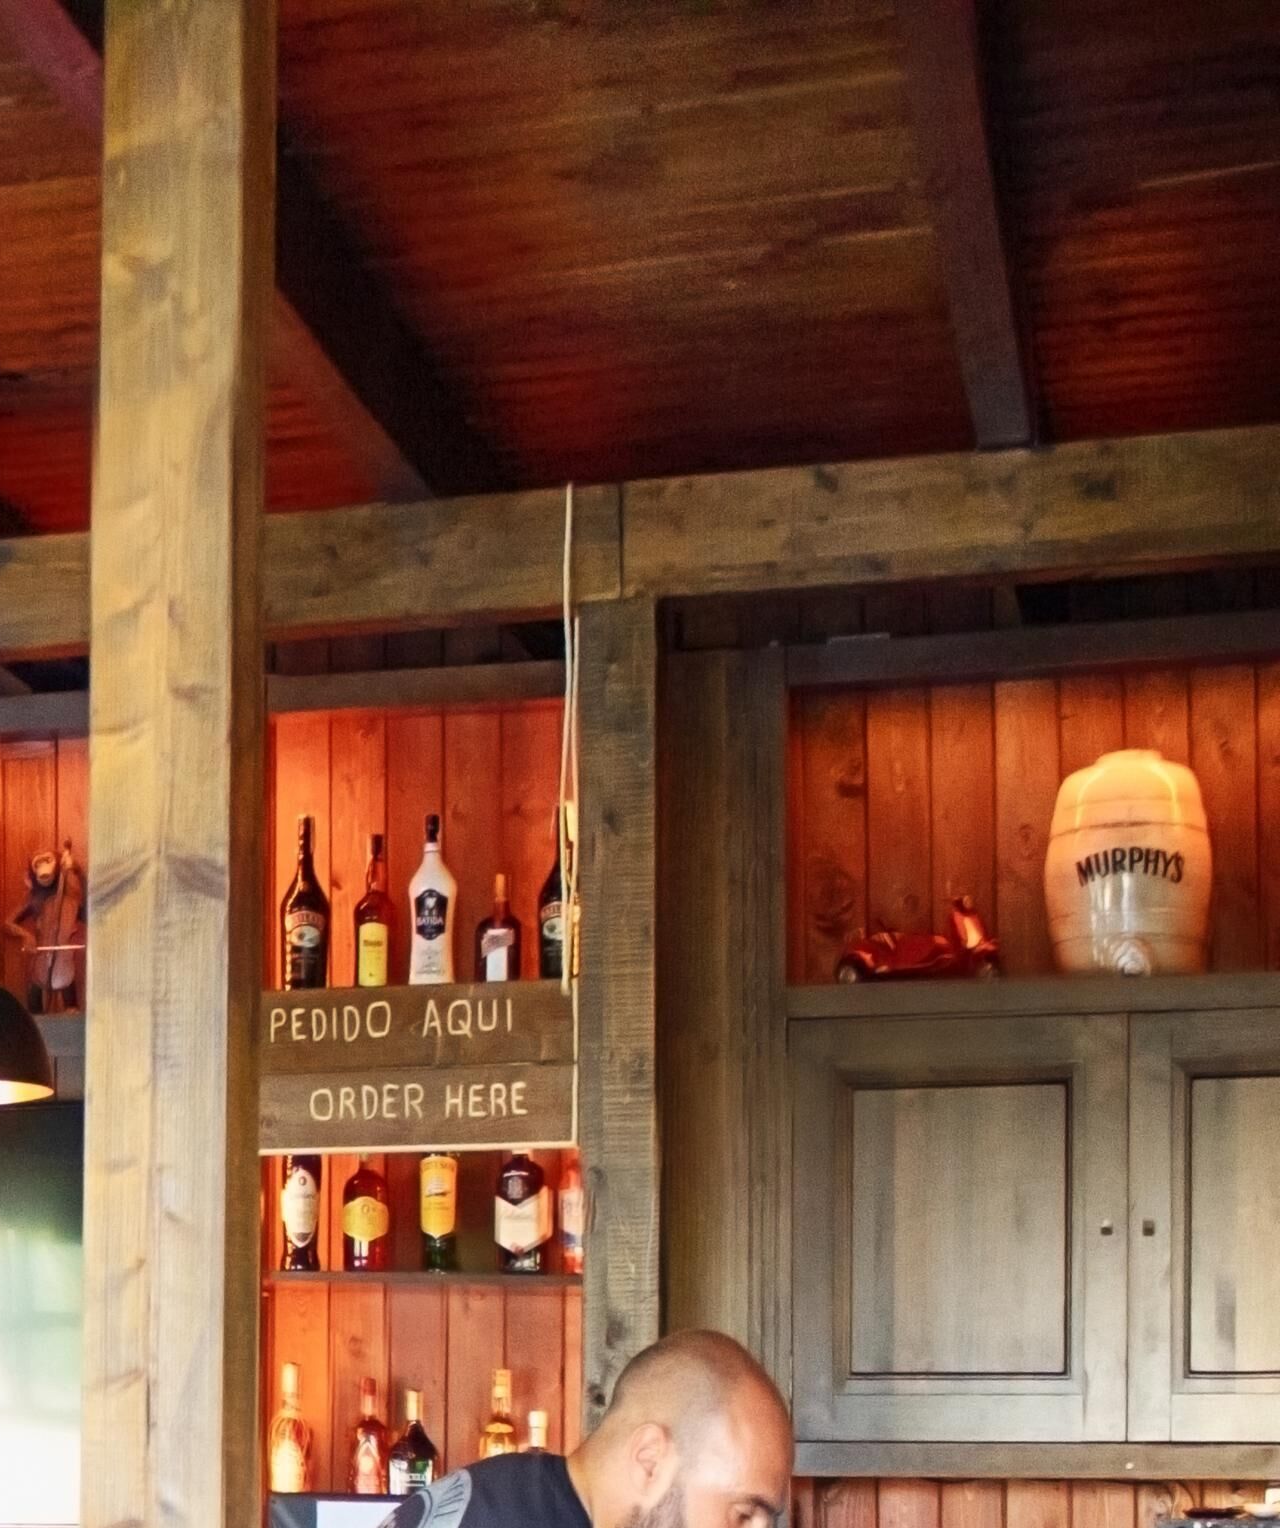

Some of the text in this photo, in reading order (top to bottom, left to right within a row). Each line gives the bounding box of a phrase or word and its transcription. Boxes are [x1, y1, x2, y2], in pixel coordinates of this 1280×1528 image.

[1075, 846, 1185, 888] MURPHY'S
[268, 998, 513, 1044] PEDIDO AQUI
[309, 1081, 529, 1121] ORDER HERE
